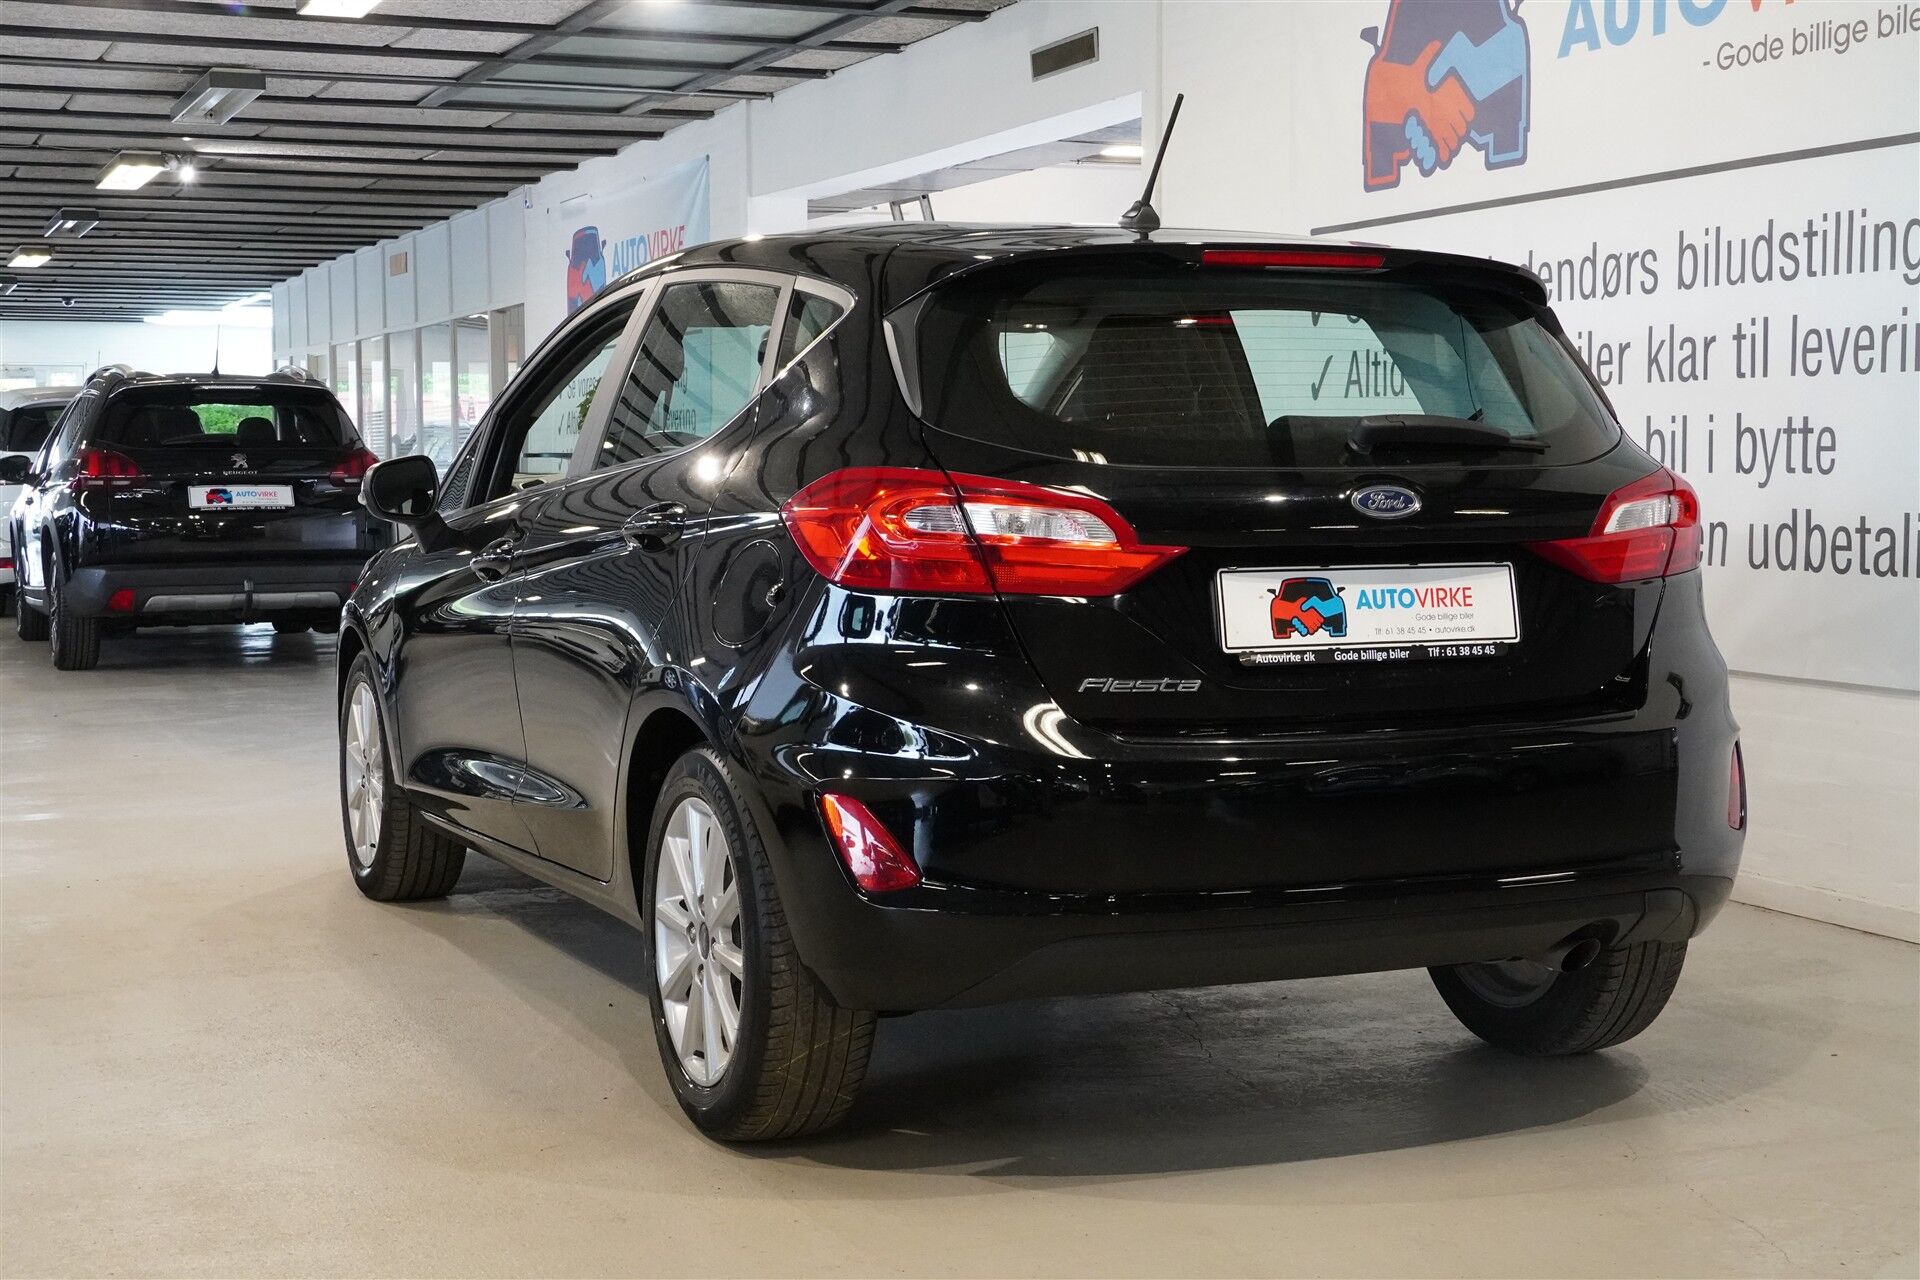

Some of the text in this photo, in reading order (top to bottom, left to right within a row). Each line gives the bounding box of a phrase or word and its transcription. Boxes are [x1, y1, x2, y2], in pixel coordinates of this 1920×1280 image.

[1716, 34, 1784, 71] Gode
[1791, 19, 1869, 56] billige
[1646, 323, 1717, 384] klar
[1732, 316, 1769, 380] til
[1790, 306, 1920, 378] leveri
[1707, 413, 1714, 474] i
[1735, 412, 1837, 489] bytte
[235, 490, 278, 498] AUTOVIRKE
[1367, 491, 1406, 510] Ford
[1356, 586, 1474, 611] AUTOVIRKE
[1415, 611, 1475, 622] Gode billige biler
[1255, 652, 1301, 664] Autovirke
[1303, 651, 1316, 662] dk
[1334, 650, 1359, 661] Gode
[1360, 649, 1388, 661] billige
[1390, 648, 1410, 659] biler
[1446, 646, 1458, 657] 61
[1459, 646, 1471, 656] 38
[1471, 645, 1483, 656] 45
[1484, 645, 1496, 655] 45
